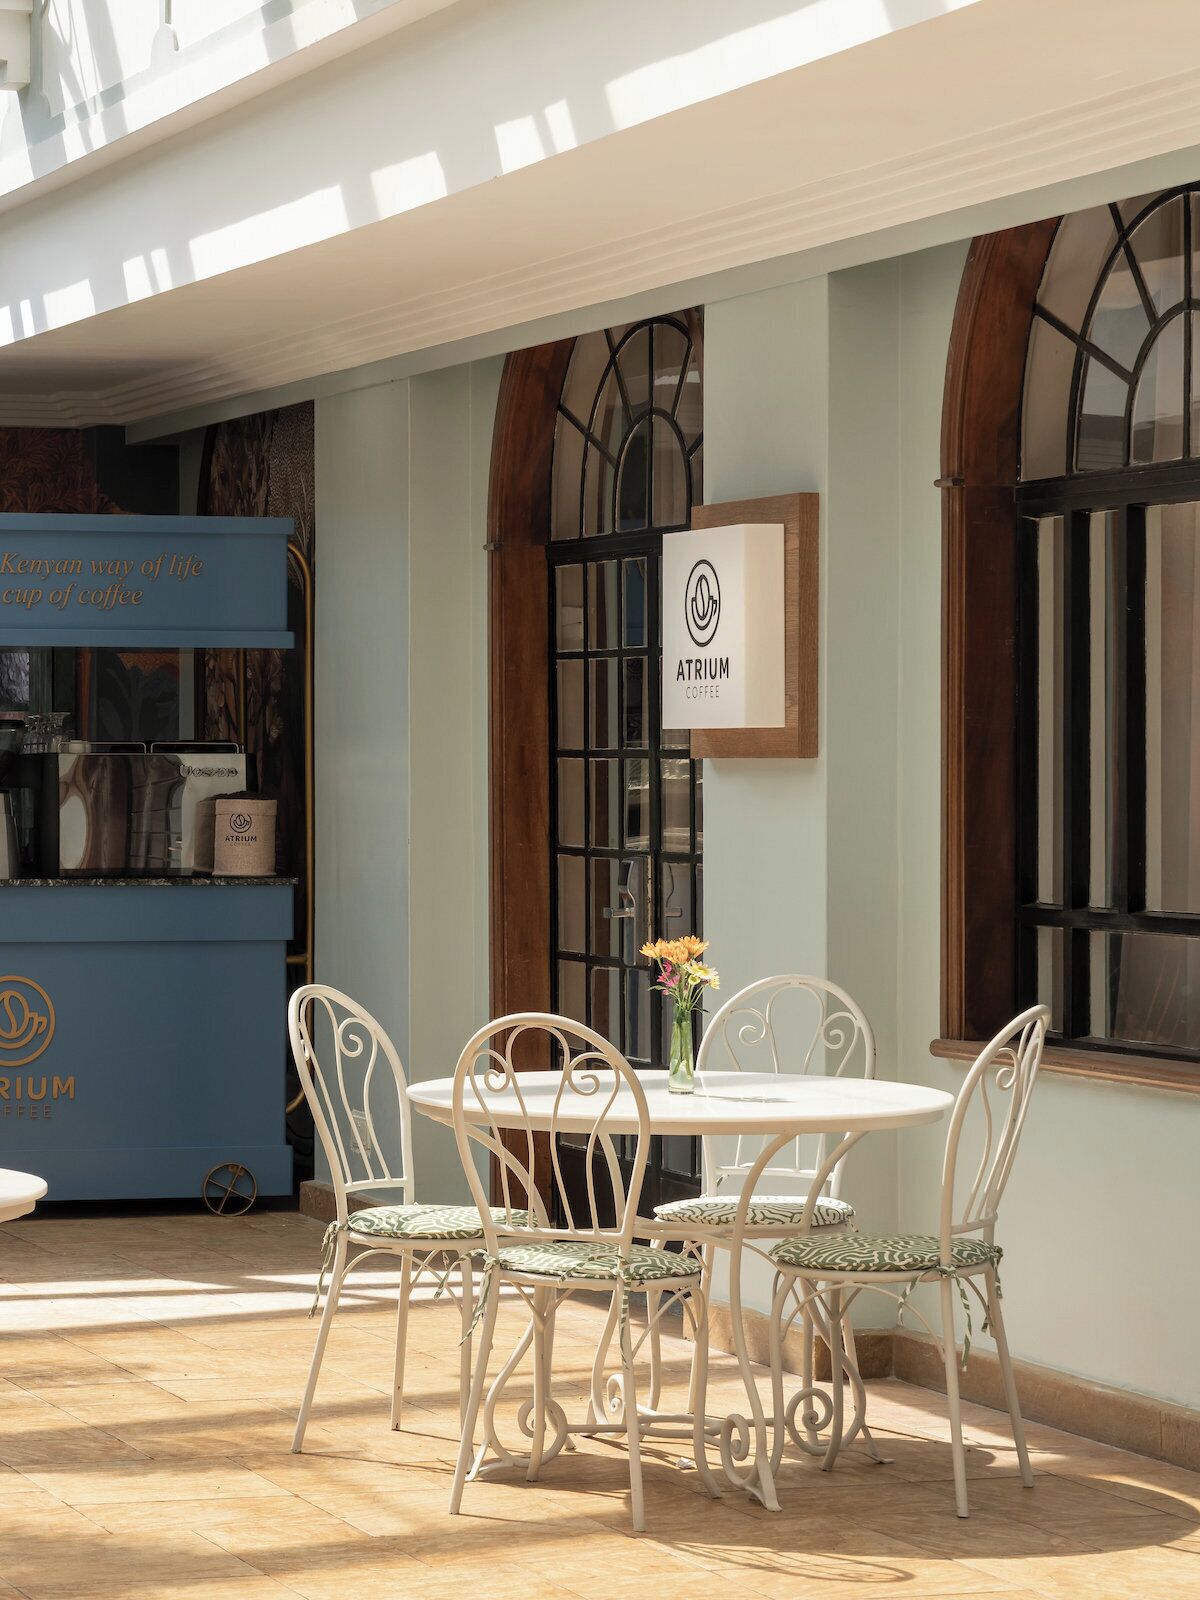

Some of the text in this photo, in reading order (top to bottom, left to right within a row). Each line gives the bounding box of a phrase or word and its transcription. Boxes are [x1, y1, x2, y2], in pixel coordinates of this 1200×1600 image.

[0, 552, 83, 580] Kenyan
[91, 559, 134, 581] way
[140, 553, 167, 581] of
[168, 553, 204, 581] life
[2, 586, 43, 609] cup
[50, 583, 77, 610] of
[78, 583, 144, 610] coffee
[676, 656, 730, 682] ATRIUM
[686, 685, 720, 699] COFFEE
